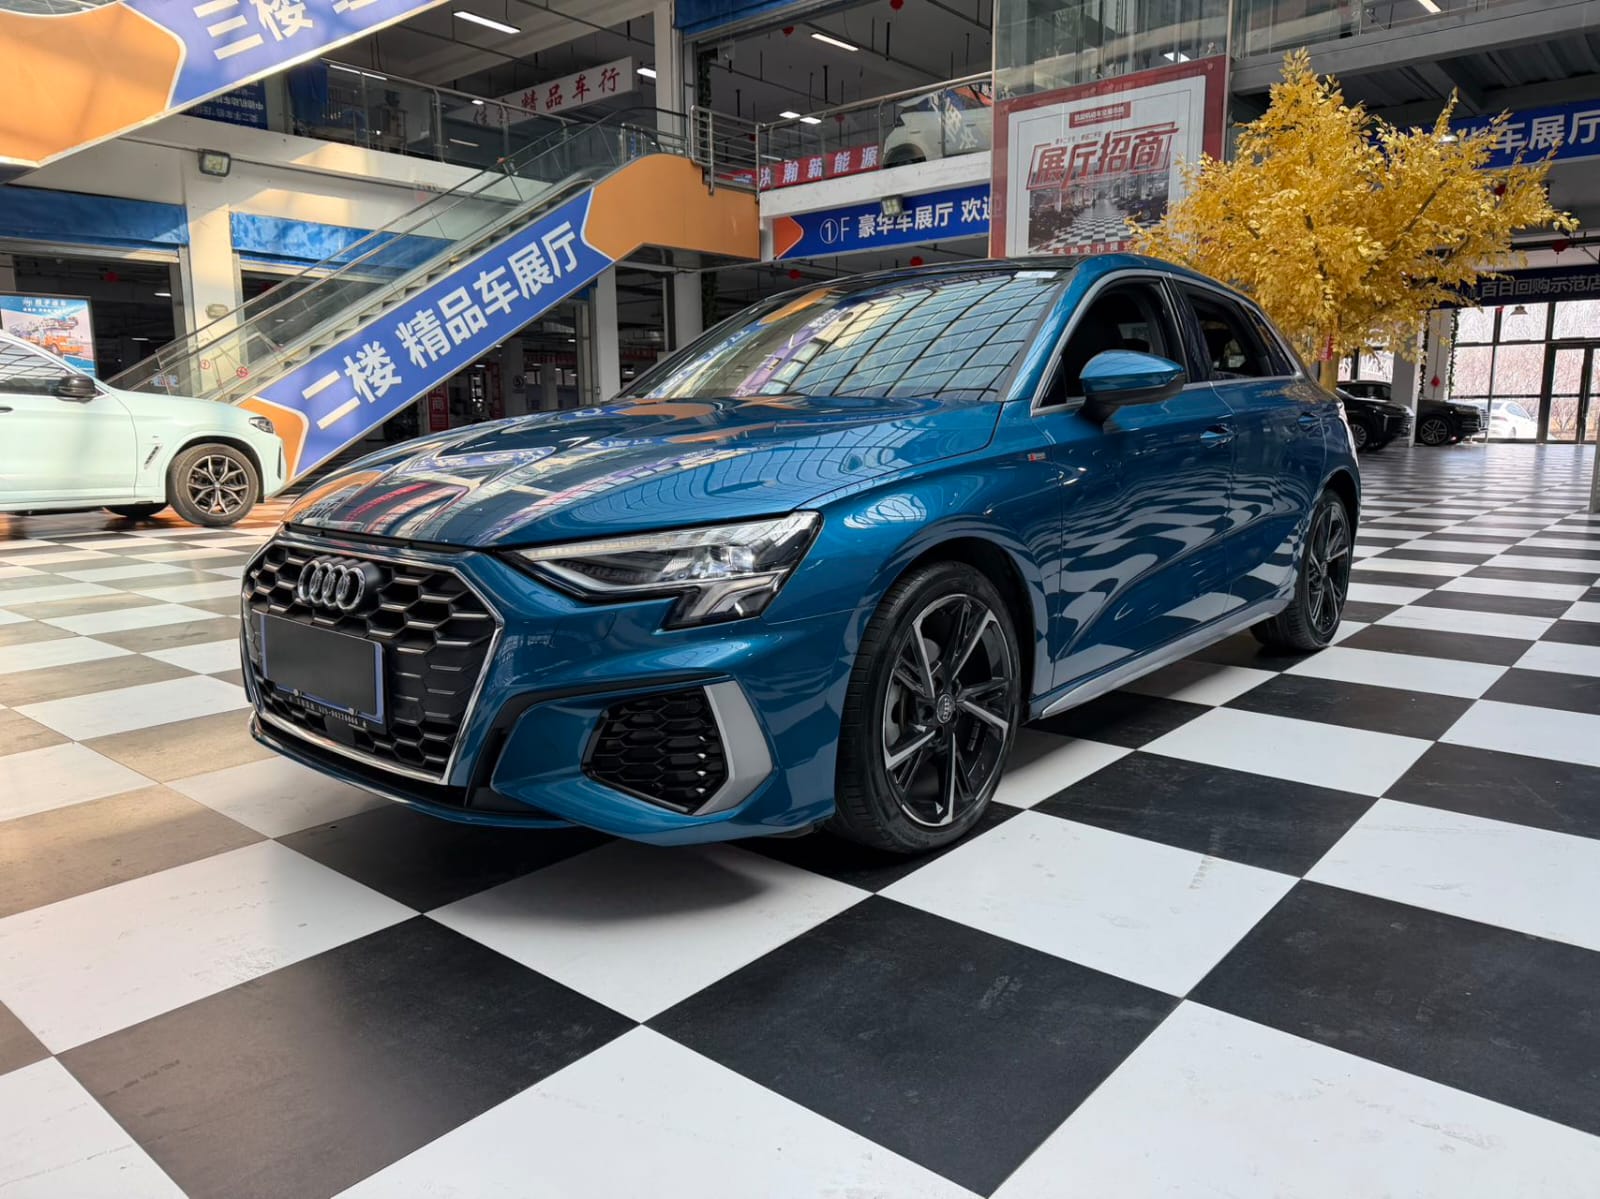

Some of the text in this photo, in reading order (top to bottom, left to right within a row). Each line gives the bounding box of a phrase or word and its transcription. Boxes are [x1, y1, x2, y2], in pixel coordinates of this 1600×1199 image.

[193, 0, 313, 60] 三楼
[1457, 109, 1600, 154] 车展厅
[1034, 127, 1180, 190] 展厅招商
[858, 202, 954, 240] 豪华车展厅
[1481, 275, 1600, 297] 百日回购示范店
[302, 220, 578, 430] 二楼 精品车展厅
